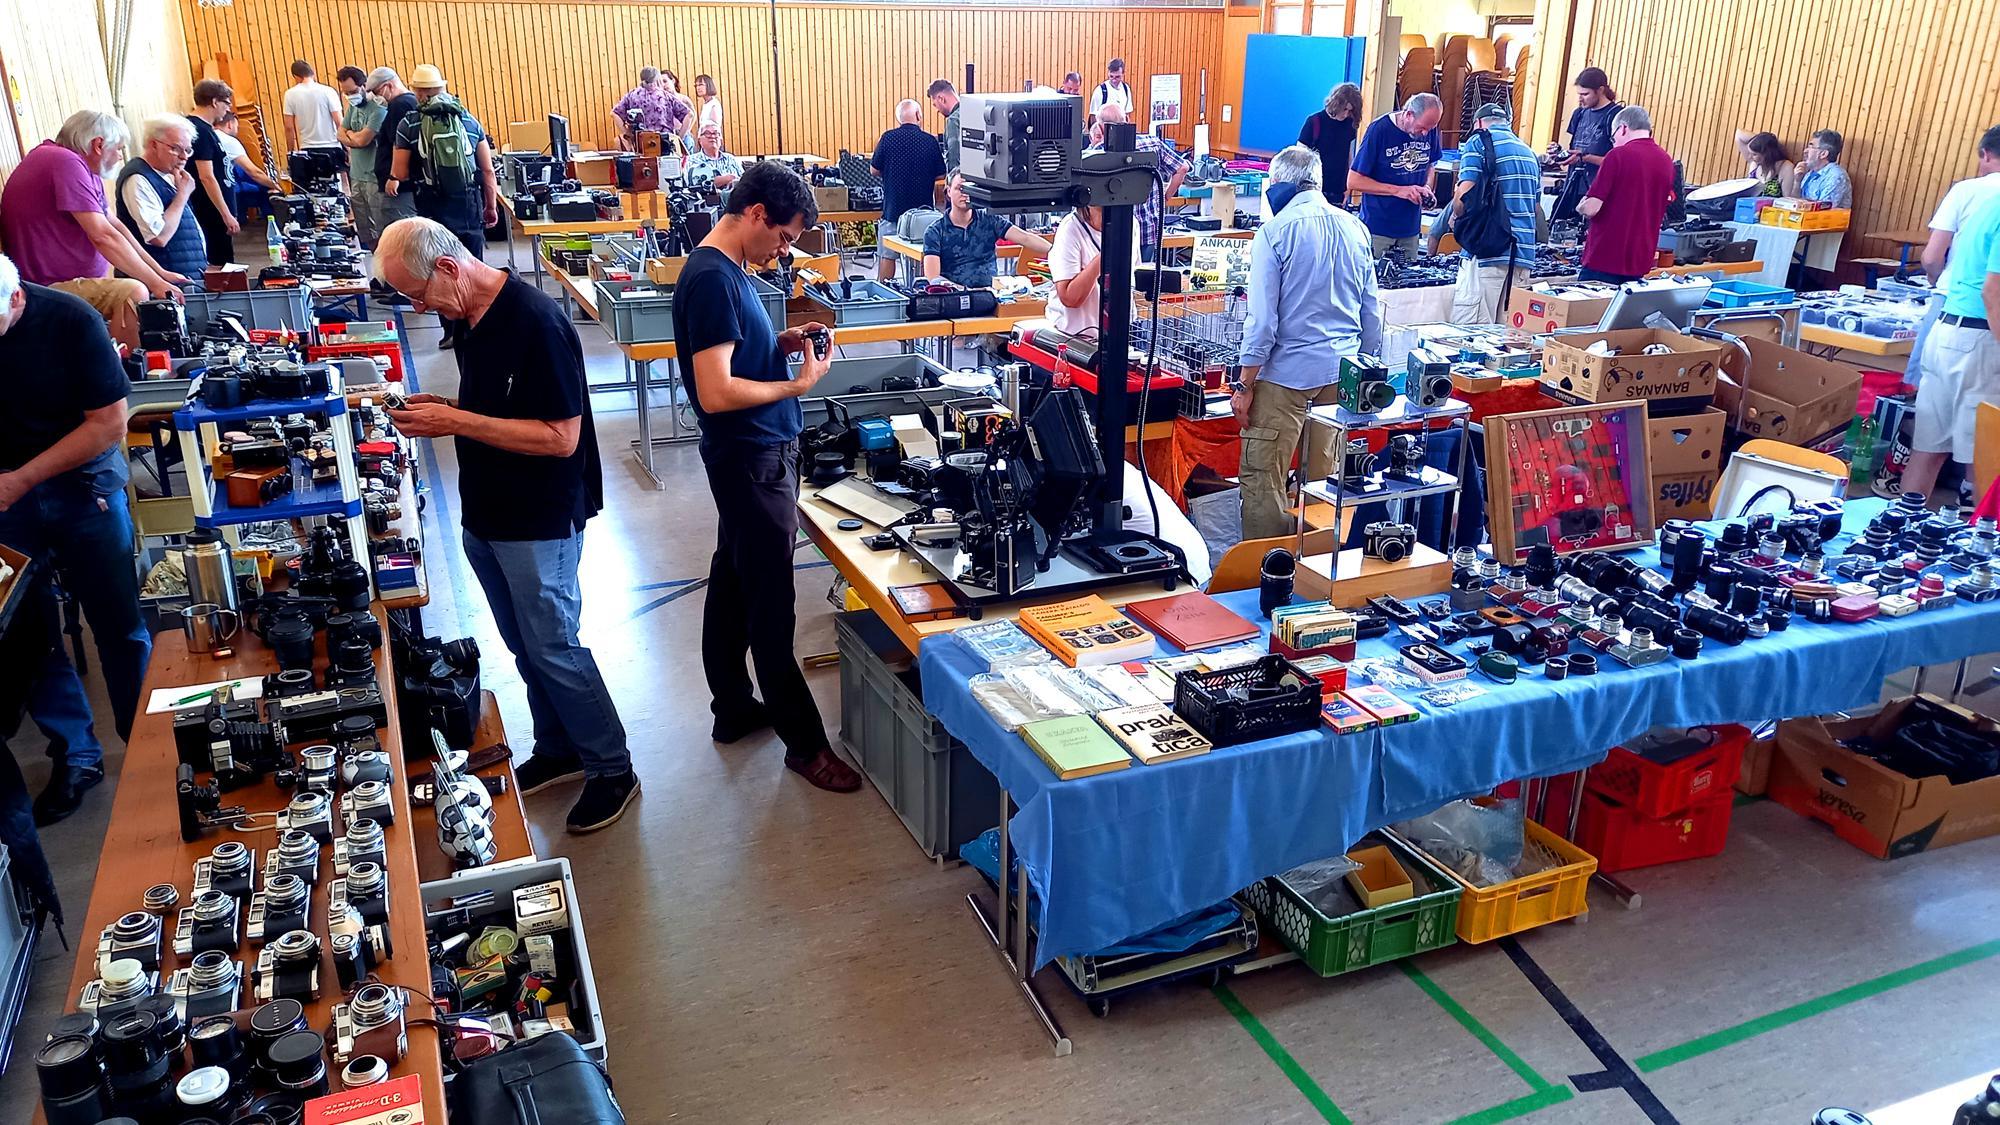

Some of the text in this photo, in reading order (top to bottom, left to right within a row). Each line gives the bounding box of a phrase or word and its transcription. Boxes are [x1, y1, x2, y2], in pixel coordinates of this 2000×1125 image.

[1385, 141, 1431, 157] ST. LUCIA
[1200, 238, 1249, 249] ANKAUF
[1625, 381, 1690, 398] BANANAS
[1117, 714, 1183, 736] prak
[1151, 736, 1208, 754] tica
